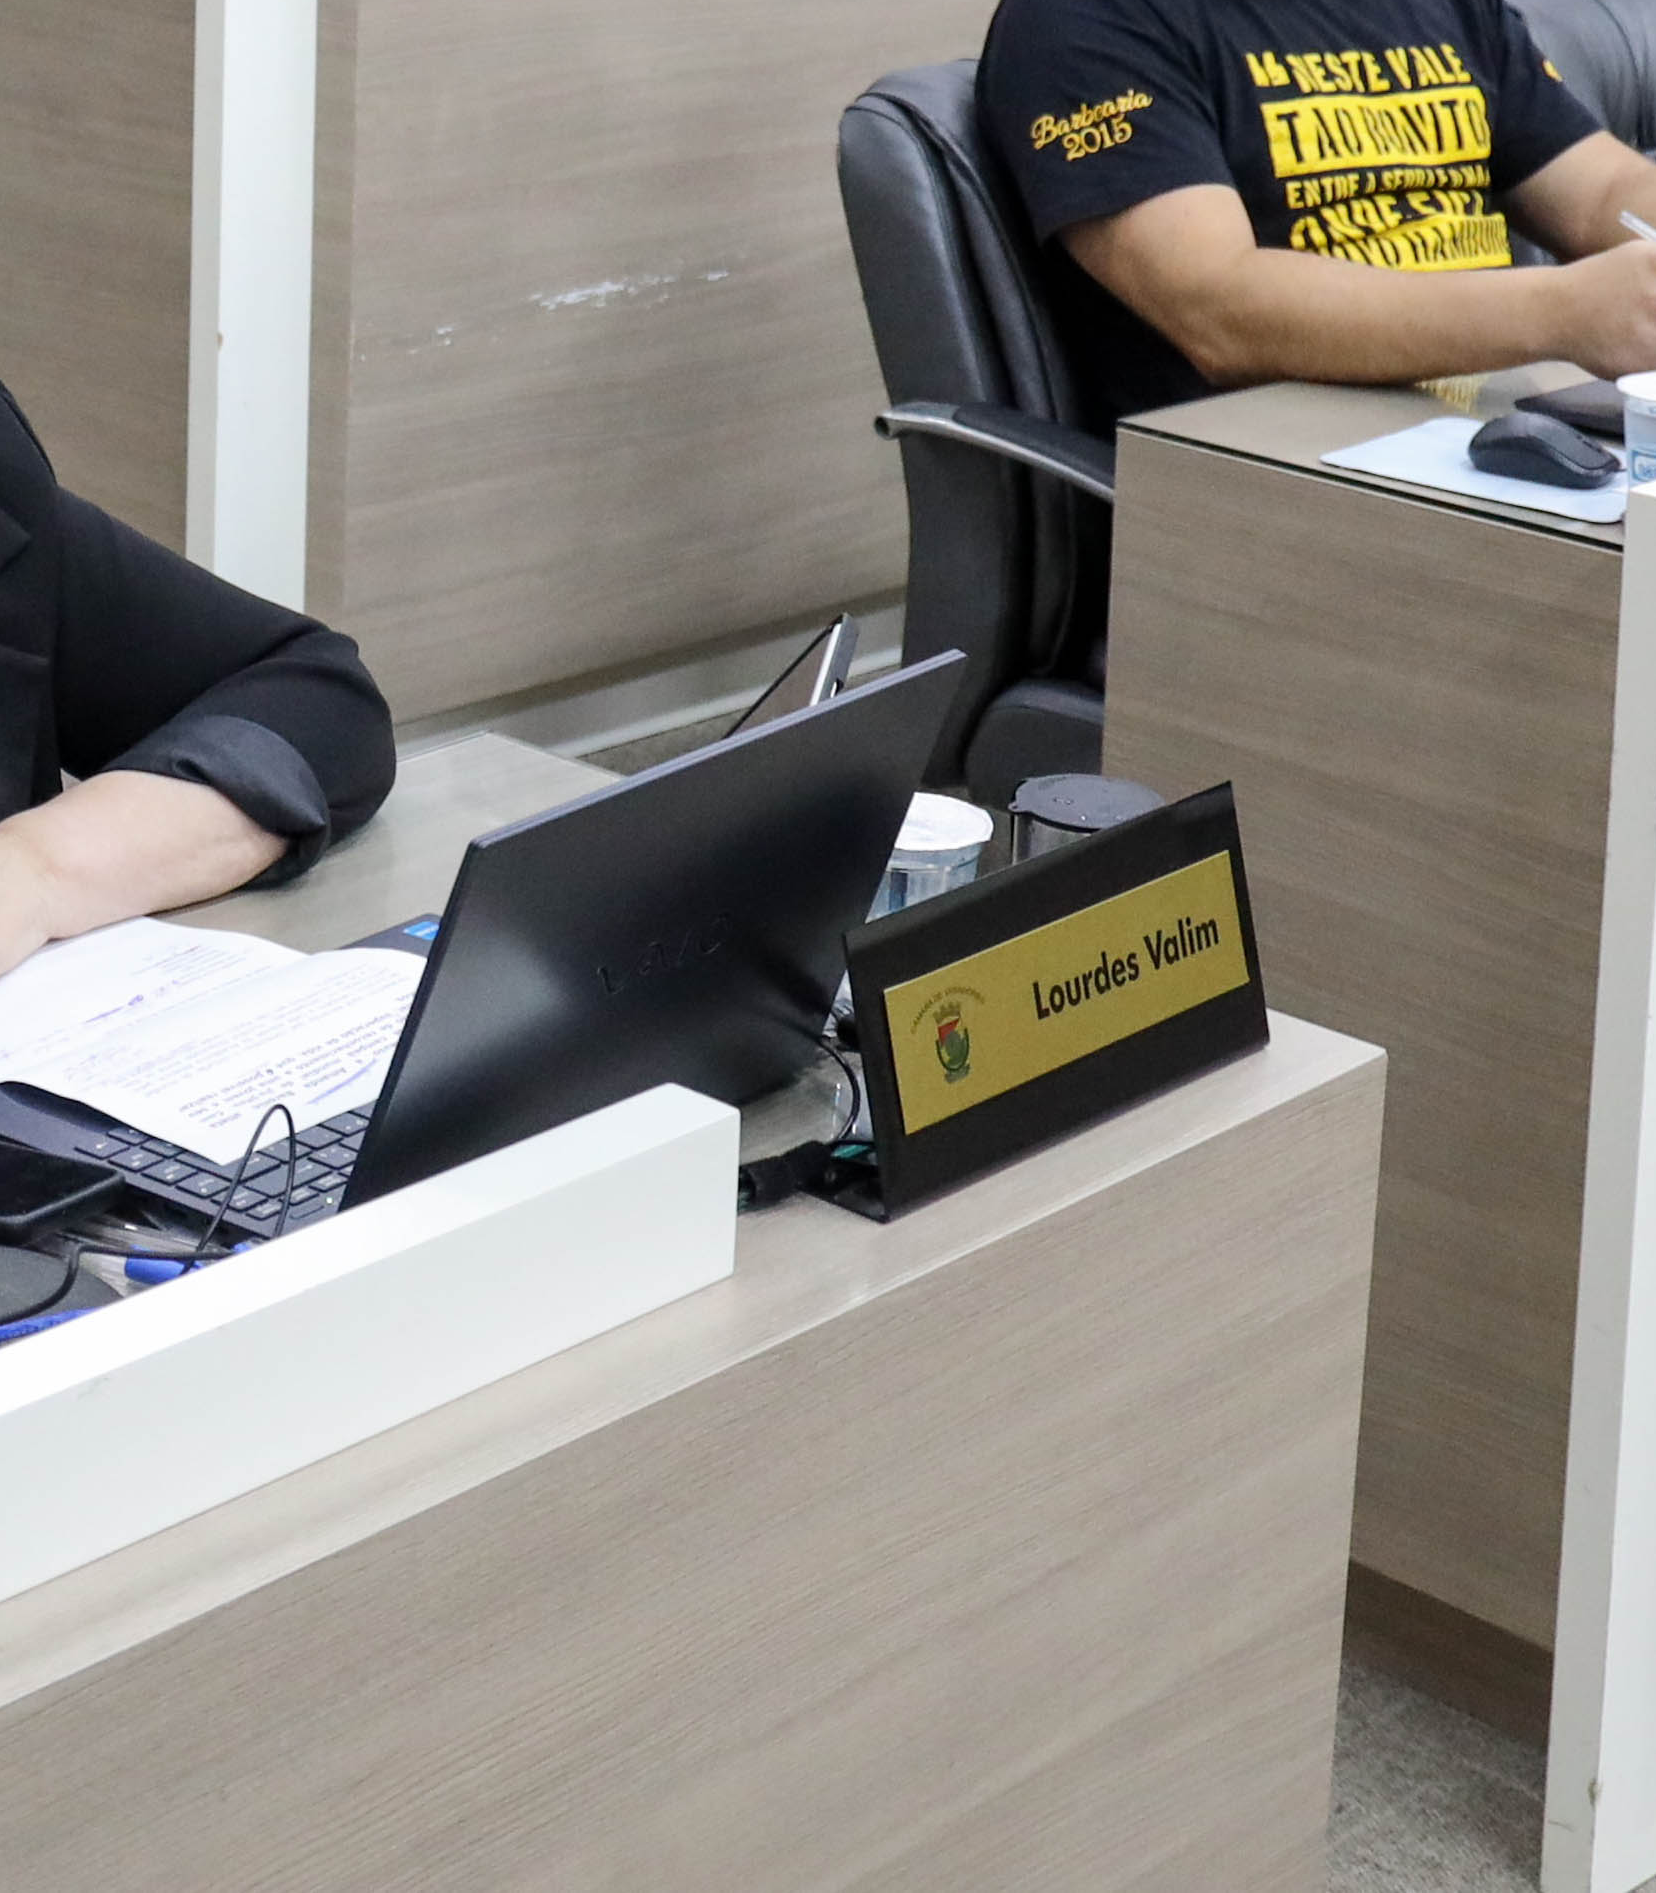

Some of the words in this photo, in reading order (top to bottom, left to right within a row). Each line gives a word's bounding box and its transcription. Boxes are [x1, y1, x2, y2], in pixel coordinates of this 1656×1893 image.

[1385, 43, 1472, 89] VALE
[1062, 113, 1133, 162] 2015
[1032, 951, 1140, 1020] Lourdes
[1143, 916, 1220, 970] Valim
